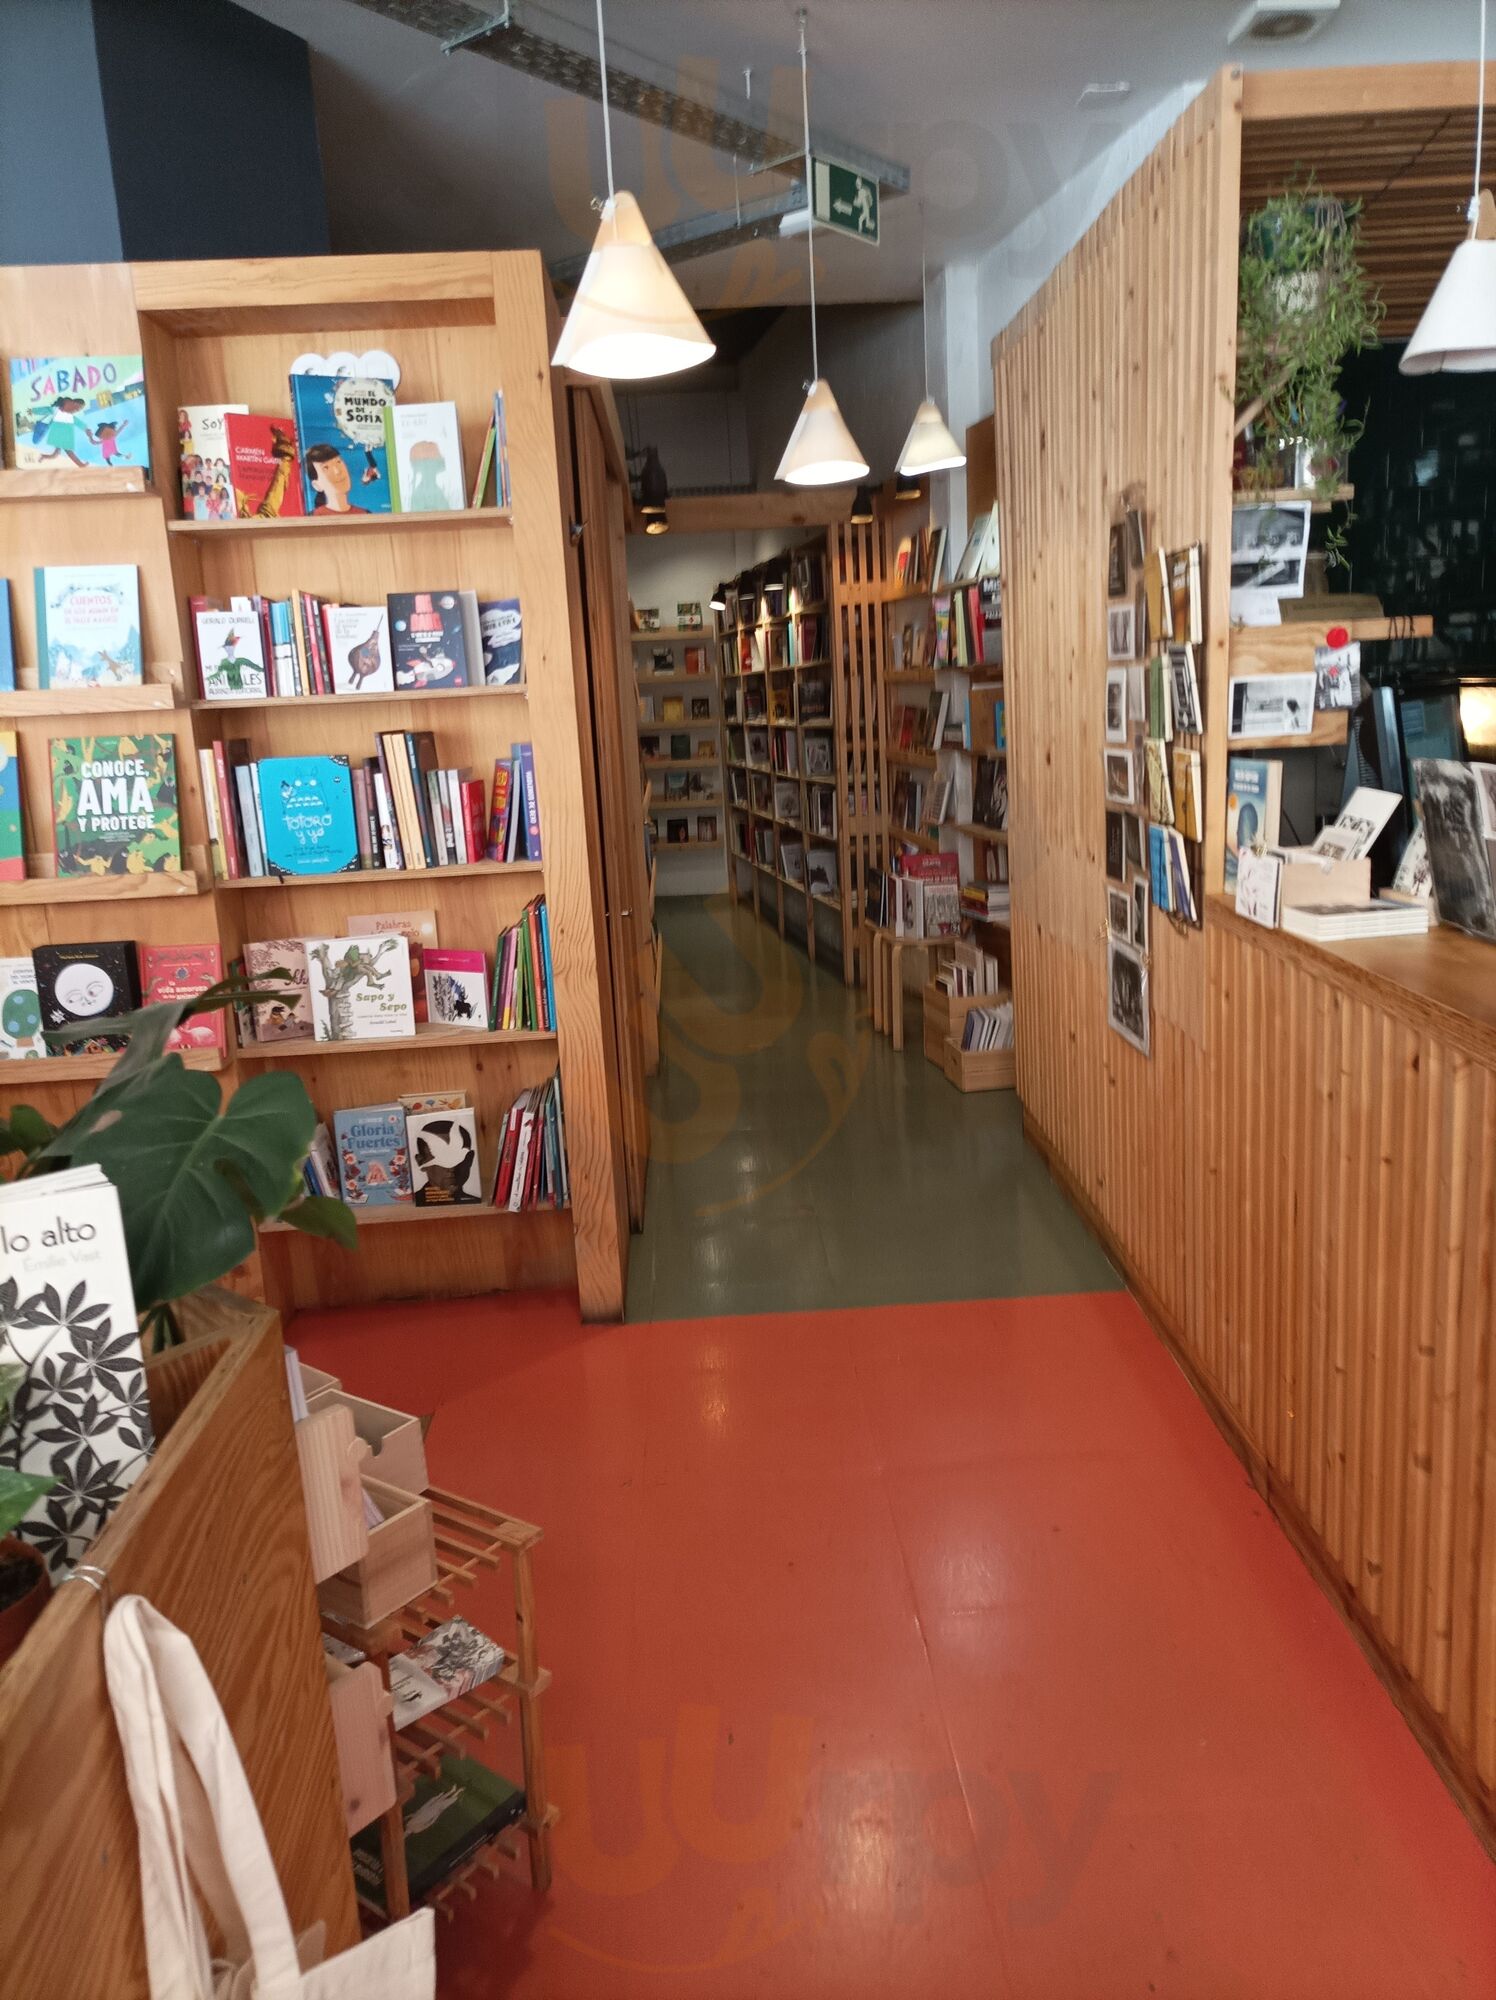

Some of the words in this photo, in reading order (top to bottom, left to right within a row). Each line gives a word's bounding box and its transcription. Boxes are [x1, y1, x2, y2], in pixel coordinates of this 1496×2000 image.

[344, 397, 387, 407] MUNDO
[346, 409, 382, 423] SOFÍA
[81, 760, 149, 777] CONOCE,
[77, 777, 154, 816] AMA
[78, 816, 87, 832] Y
[91, 815, 155, 831] PROTEGE
[295, 830, 306, 845] y
[306, 828, 324, 845] yo
[376, 920, 411, 930] Palabras
[157, 986, 174, 994] vida
[355, 993, 384, 1003] Sapo
[387, 993, 395, 1002] y
[379, 1002, 407, 1013] Sepo
[351, 1125, 394, 1137] Gloria
[347, 1137, 401, 1149] Fuertes
[0, 1225, 30, 1254] lo
[41, 1216, 96, 1247] alto
